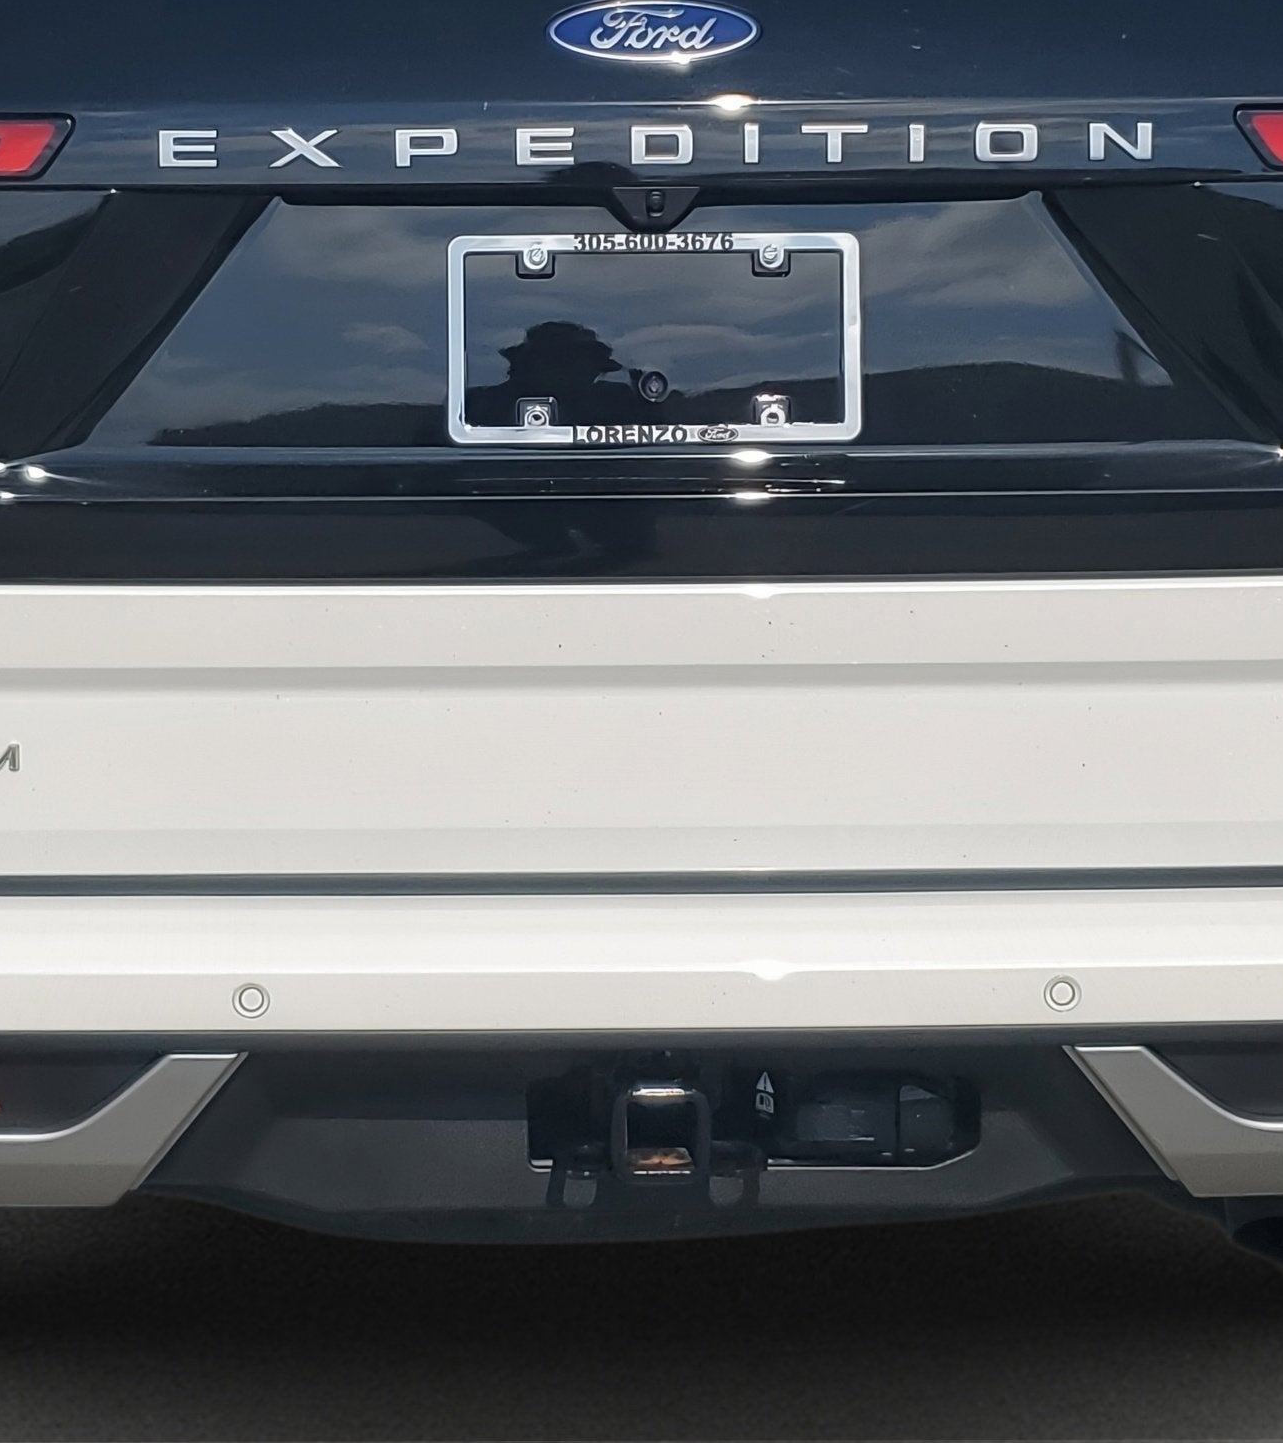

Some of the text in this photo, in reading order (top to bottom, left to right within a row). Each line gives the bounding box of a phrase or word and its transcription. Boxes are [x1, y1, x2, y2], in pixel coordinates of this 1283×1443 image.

[590, 8, 718, 50] Ford
[158, 122, 1153, 169] EXPEDITION
[573, 233, 734, 251] 305-600-3676
[573, 425, 688, 444] LORENZO
